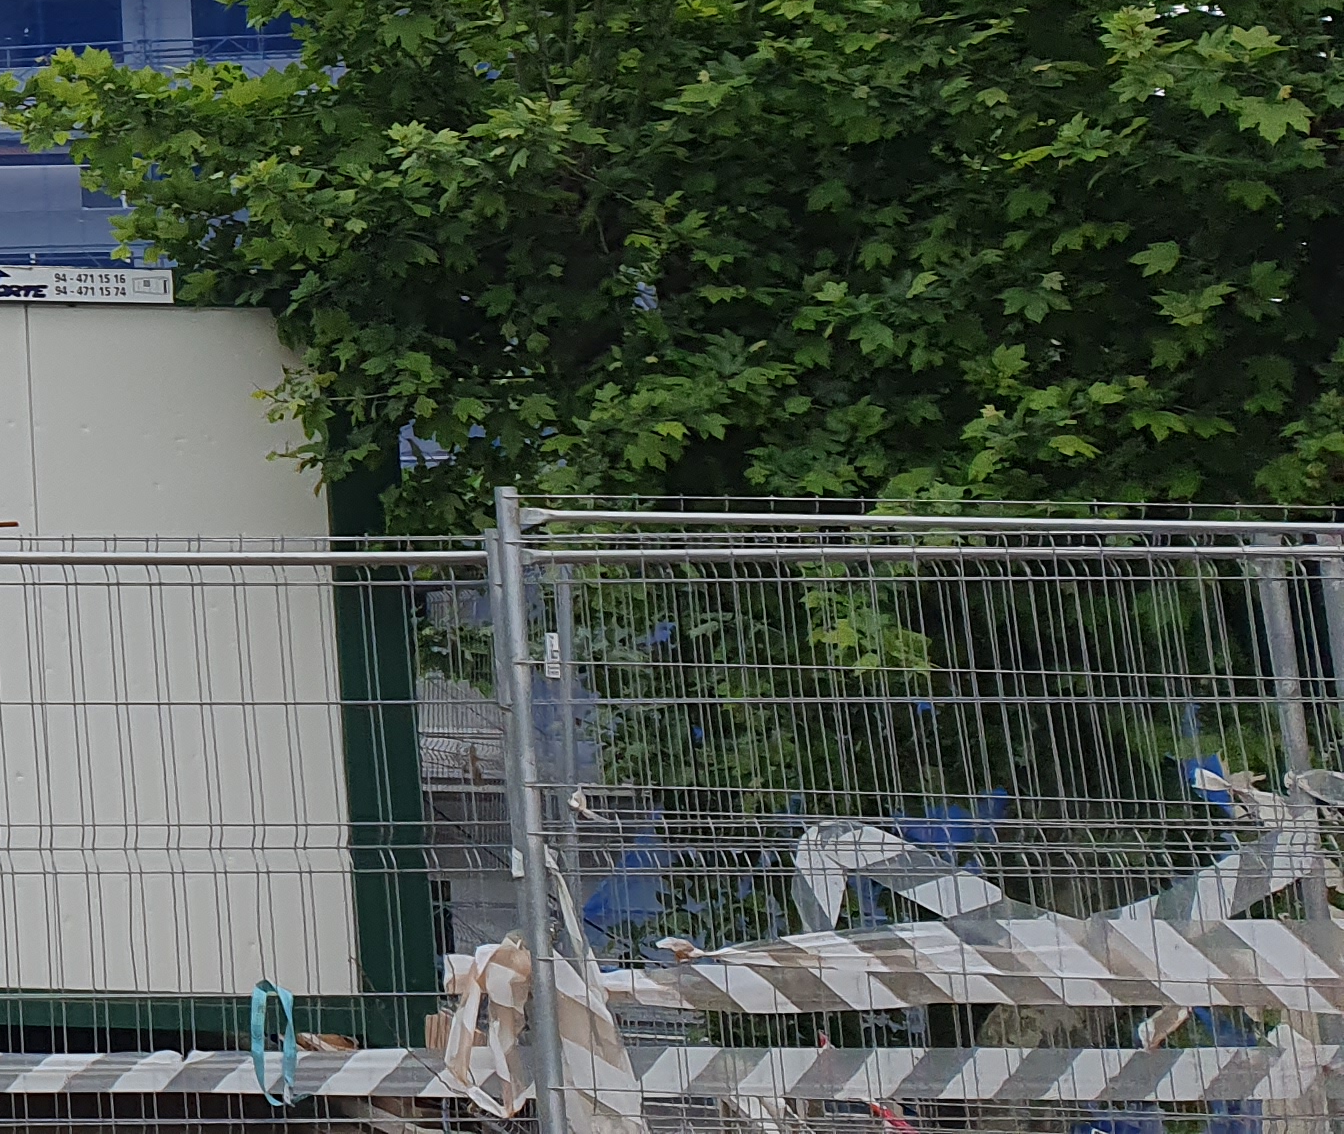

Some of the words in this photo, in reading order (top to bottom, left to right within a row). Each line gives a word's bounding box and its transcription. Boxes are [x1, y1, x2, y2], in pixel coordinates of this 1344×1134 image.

[54, 273, 67, 283] 94
[76, 273, 94, 284] 471
[98, 273, 110, 284] 15
[114, 273, 126, 284] 16
[55, 285, 68, 296] 94
[76, 286, 95, 296] 471
[99, 286, 111, 297] 15
[115, 286, 127, 297] 74
